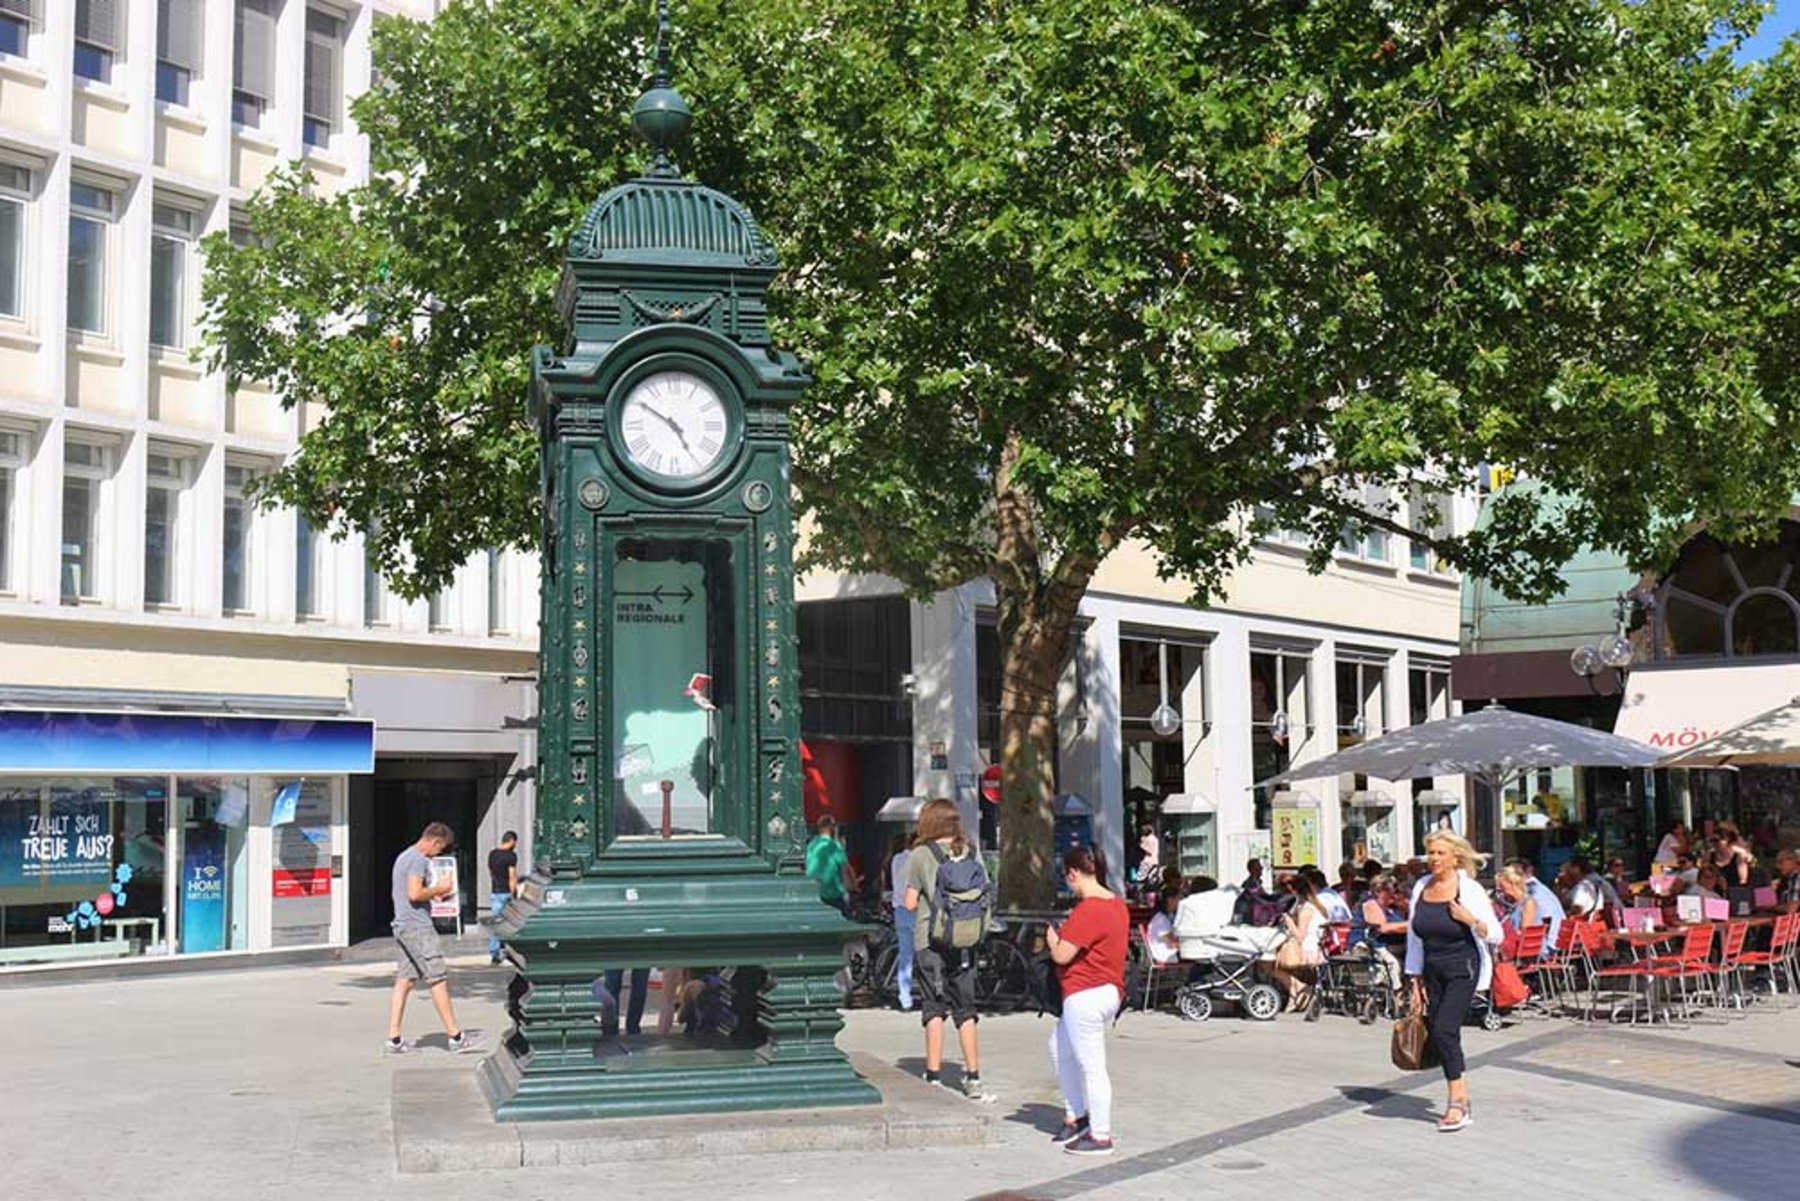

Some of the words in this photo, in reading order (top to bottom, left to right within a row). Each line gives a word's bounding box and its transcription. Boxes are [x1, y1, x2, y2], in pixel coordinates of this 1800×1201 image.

[616, 603, 653, 613] INTRA
[616, 613, 685, 623] REGIONALE
[1649, 727, 1721, 747] MÖV
[22, 837, 69, 860] TREUE
[76, 834, 114, 860] AUS?
[194, 867, 201, 880] I
